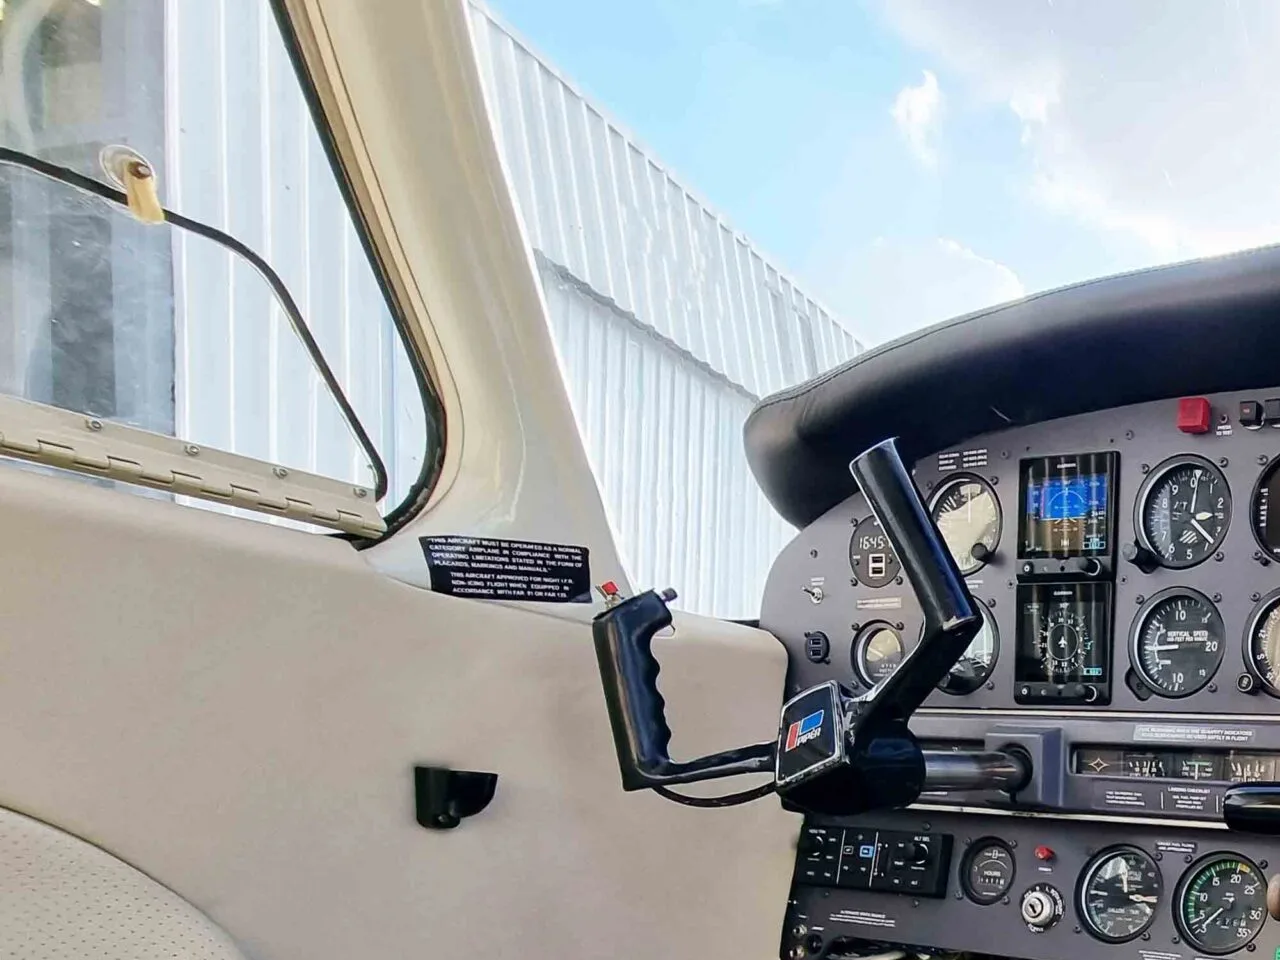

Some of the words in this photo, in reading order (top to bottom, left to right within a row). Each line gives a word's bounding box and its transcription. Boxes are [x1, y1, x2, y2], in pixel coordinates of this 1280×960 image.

[1175, 610, 1186, 621] 10
[1205, 641, 1218, 652] 20
[1173, 672, 1184, 683] 10
[1231, 874, 1242, 883] 20
[1244, 885, 1255, 895] 25
[1249, 911, 1262, 920] 30
[1237, 928, 1248, 937] 35
